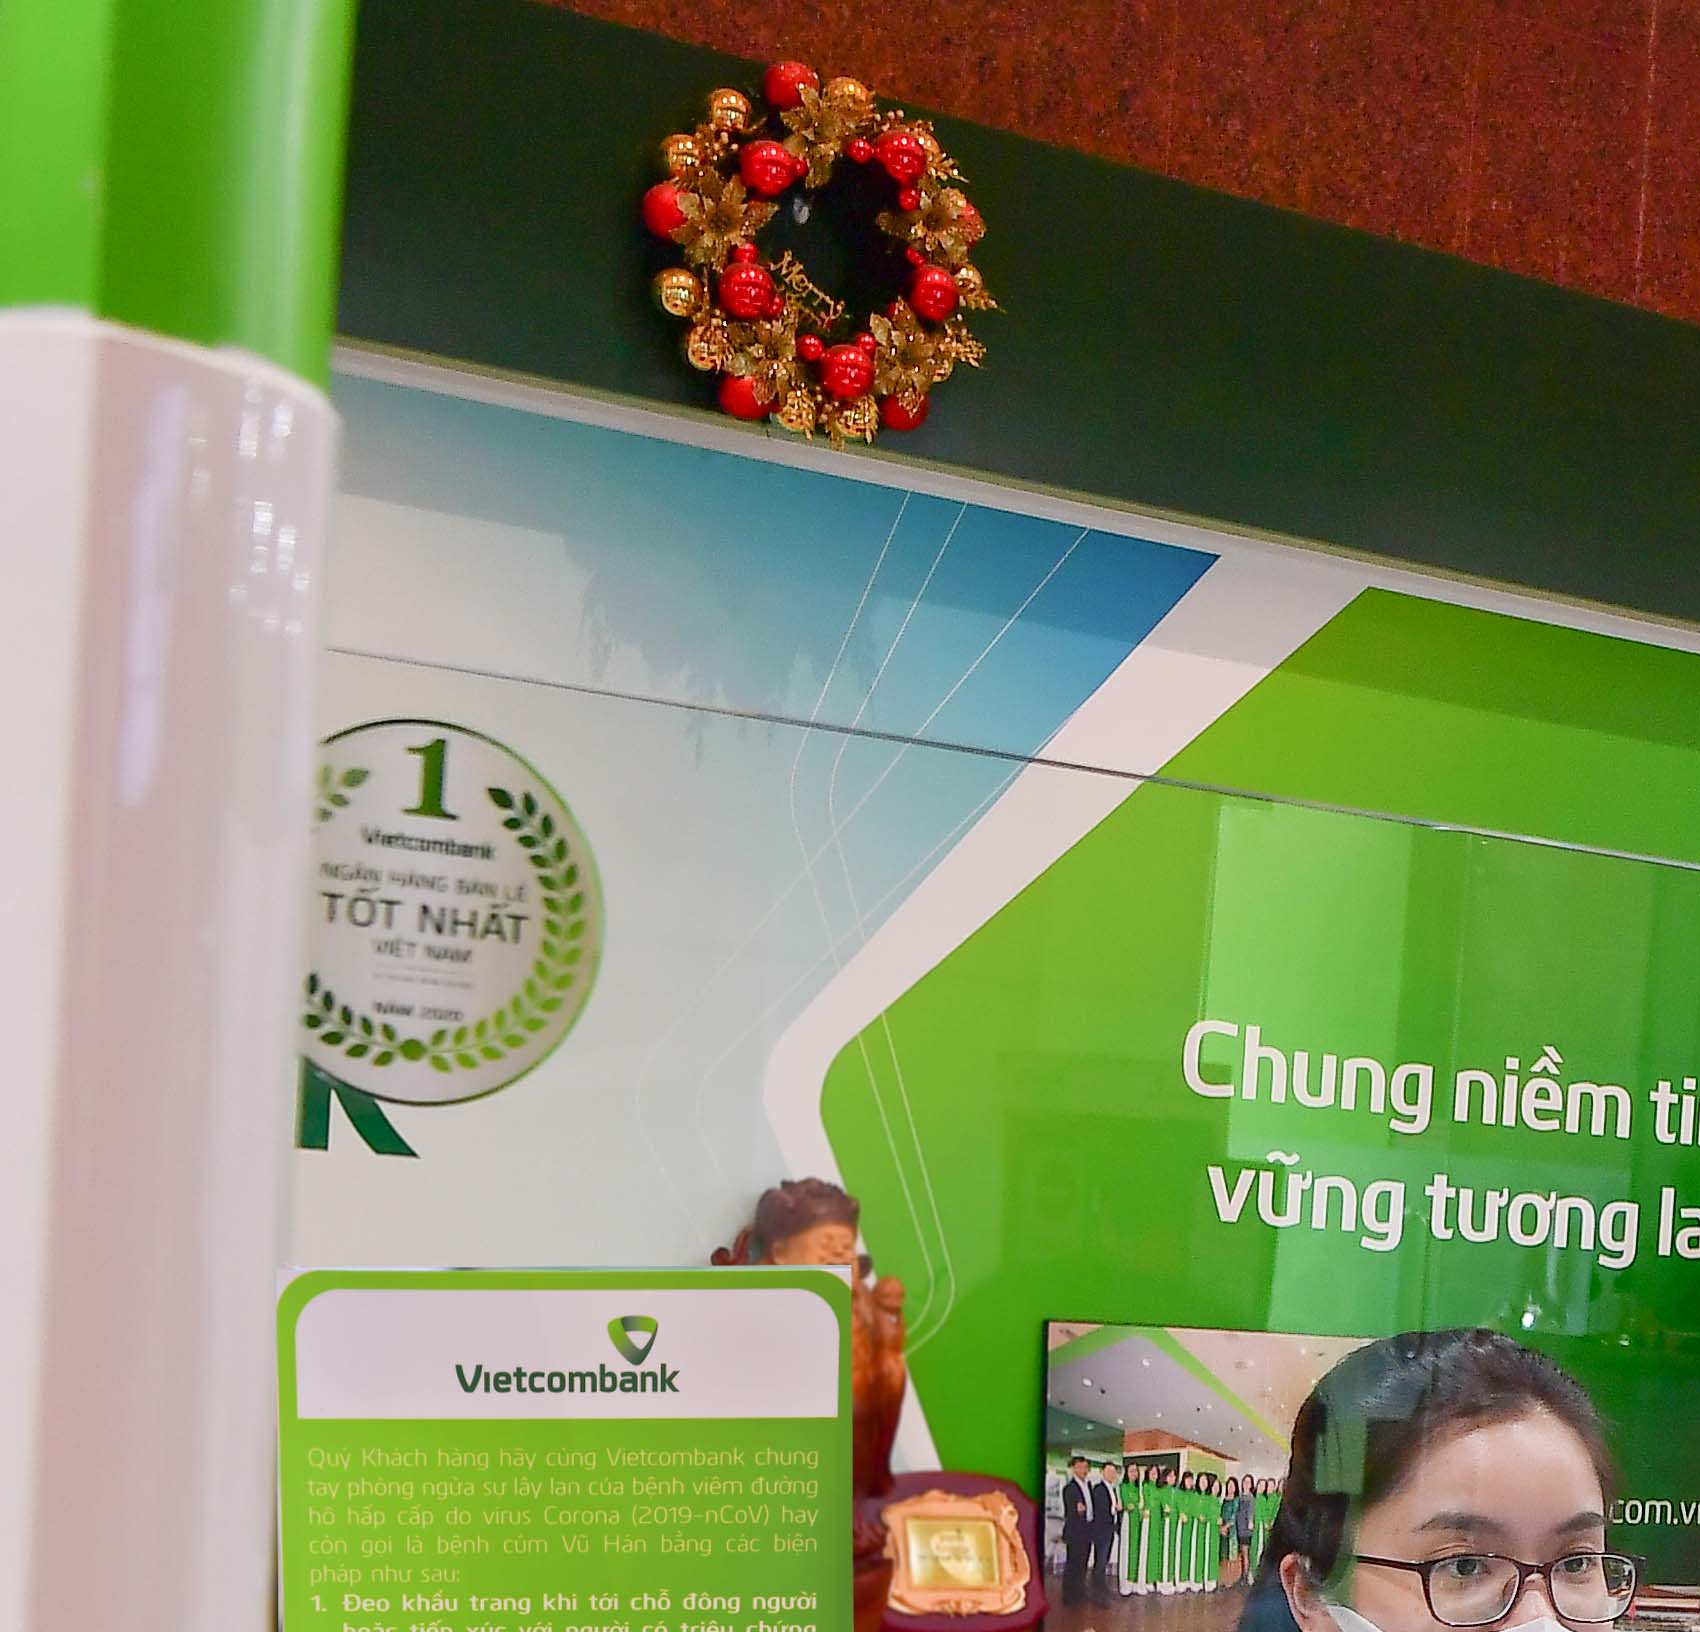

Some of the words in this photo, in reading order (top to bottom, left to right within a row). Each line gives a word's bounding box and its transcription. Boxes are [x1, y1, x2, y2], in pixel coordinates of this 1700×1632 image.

[404, 738, 459, 821] 1
[320, 887, 402, 929] TỐT
[417, 903, 530, 944] NHẤT
[1181, 1018, 1435, 1134] Chung
[1452, 1045, 1633, 1140] niềm
[1206, 1151, 1405, 1252] vững
[1424, 1171, 1640, 1270] tương
[455, 1363, 680, 1394] Vietcombank
[307, 1446, 353, 1473] Quý
[361, 1446, 428, 1469] Khách
[436, 1446, 490, 1472] hàng
[498, 1446, 537, 1472] hãy
[544, 1446, 598, 1472] cùng
[605, 1446, 746, 1468] Vietcombank
[754, 1446, 820, 1471] chung
[309, 1562, 363, 1589] pháp
[370, 1563, 413, 1585] như
[420, 1567, 461, 1584] sau:
[310, 1593, 327, 1613] 1.
[341, 1592, 391, 1614] Đeo
[401, 1589, 459, 1613] khẩu
[468, 1593, 532, 1616] trang
[542, 1591, 578, 1612] khi
[587, 1591, 620, 1612] tới
[629, 1587, 672, 1612] chỗ
[681, 1590, 742, 1615] đông
[751, 1590, 818, 1615] người
